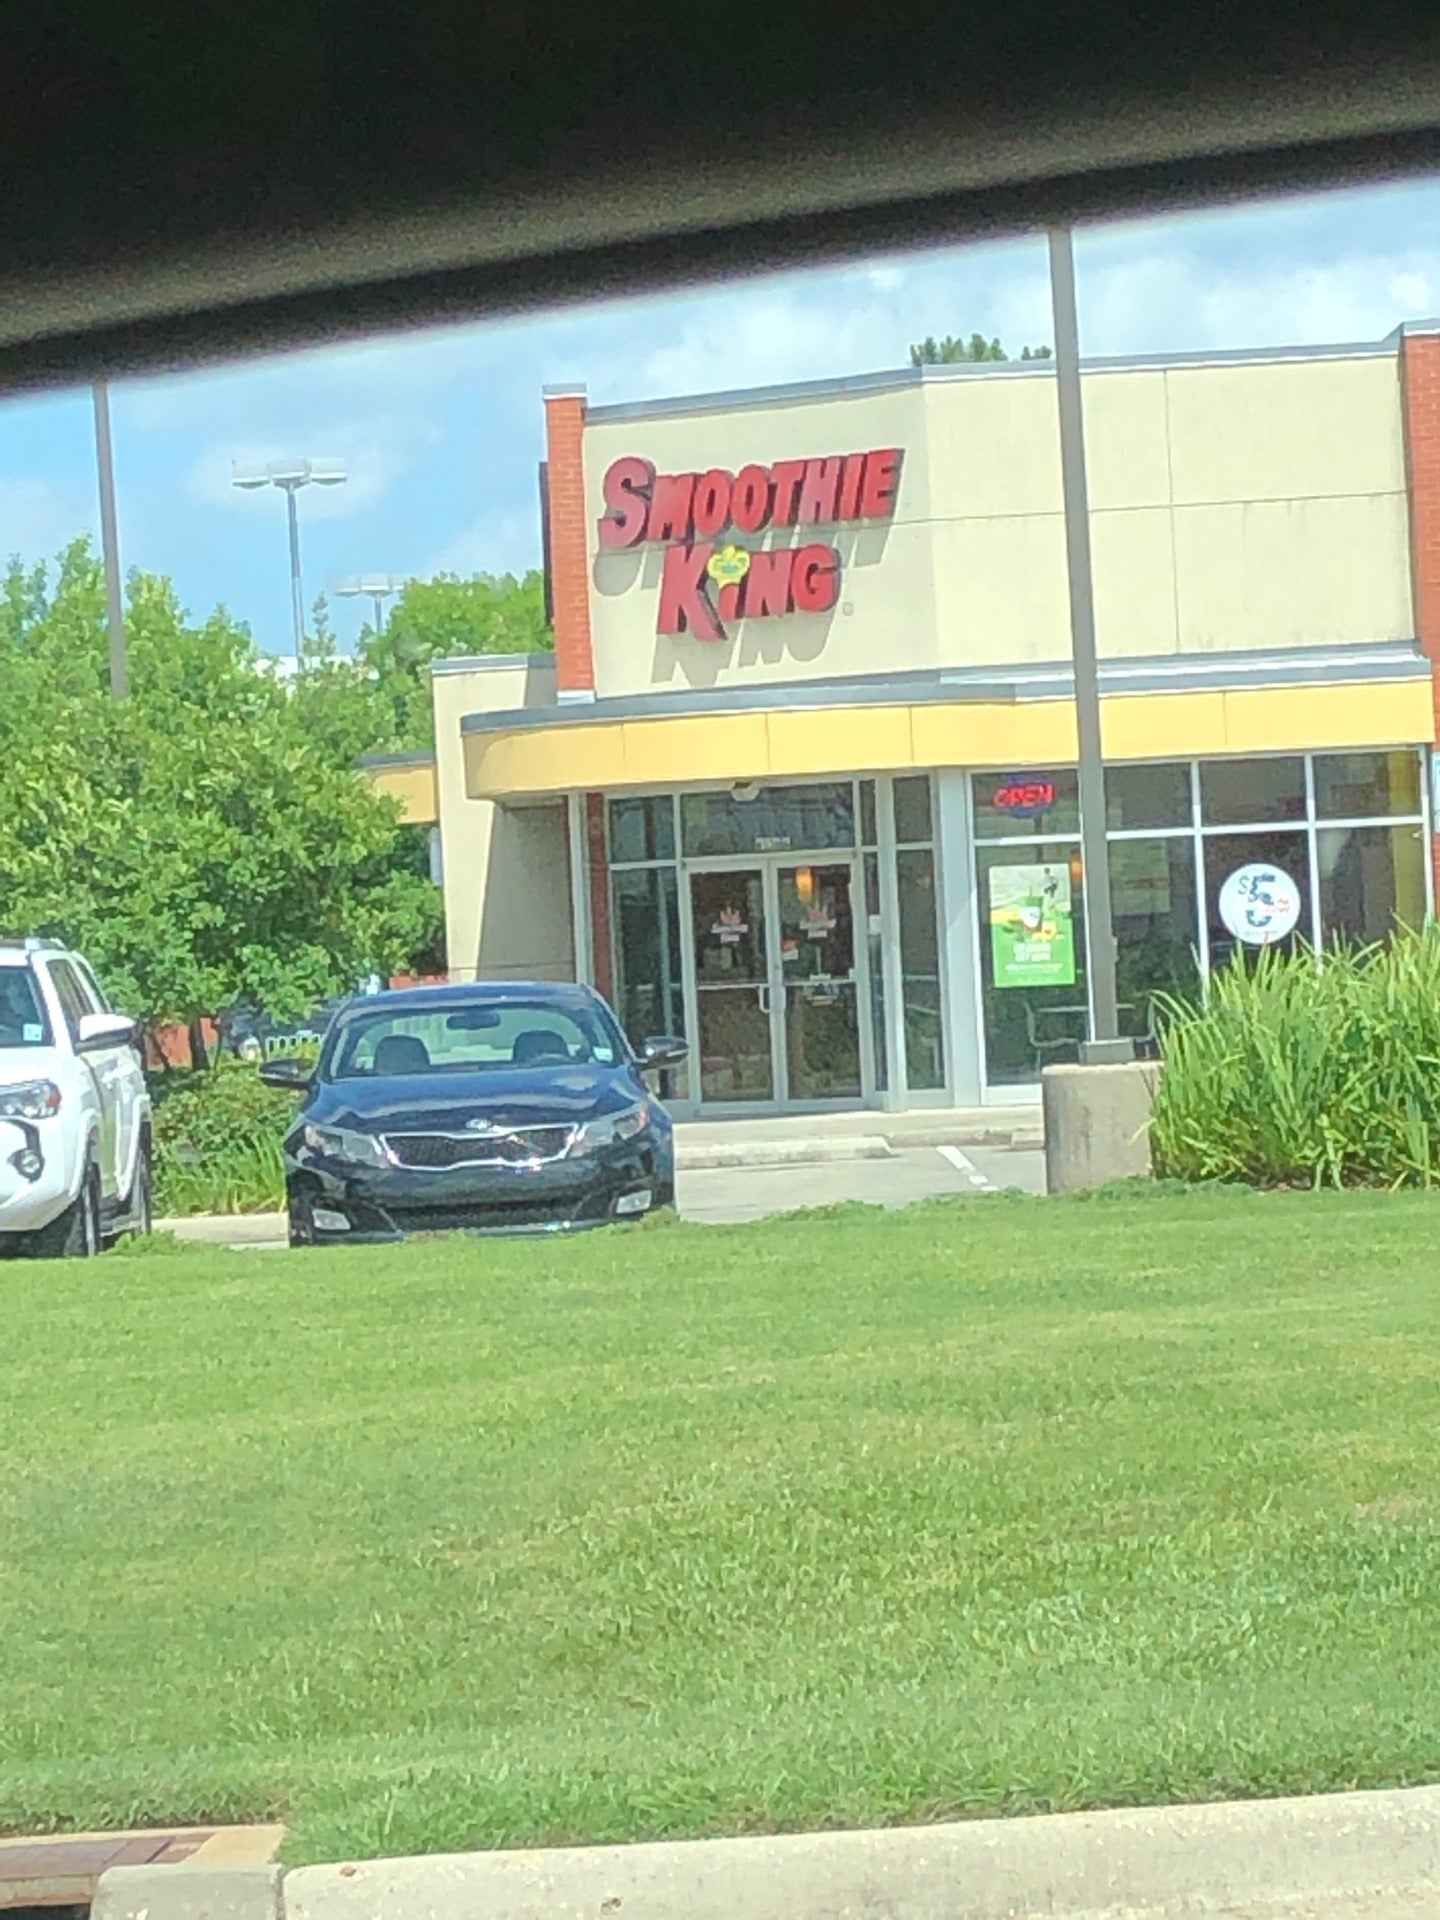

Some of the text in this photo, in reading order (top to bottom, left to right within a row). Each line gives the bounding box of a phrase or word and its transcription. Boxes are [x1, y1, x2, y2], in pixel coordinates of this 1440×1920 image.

[597, 448, 905, 548] SMOOTHIE
[656, 542, 841, 641] KING
[993, 783, 1053, 808] OPEN
